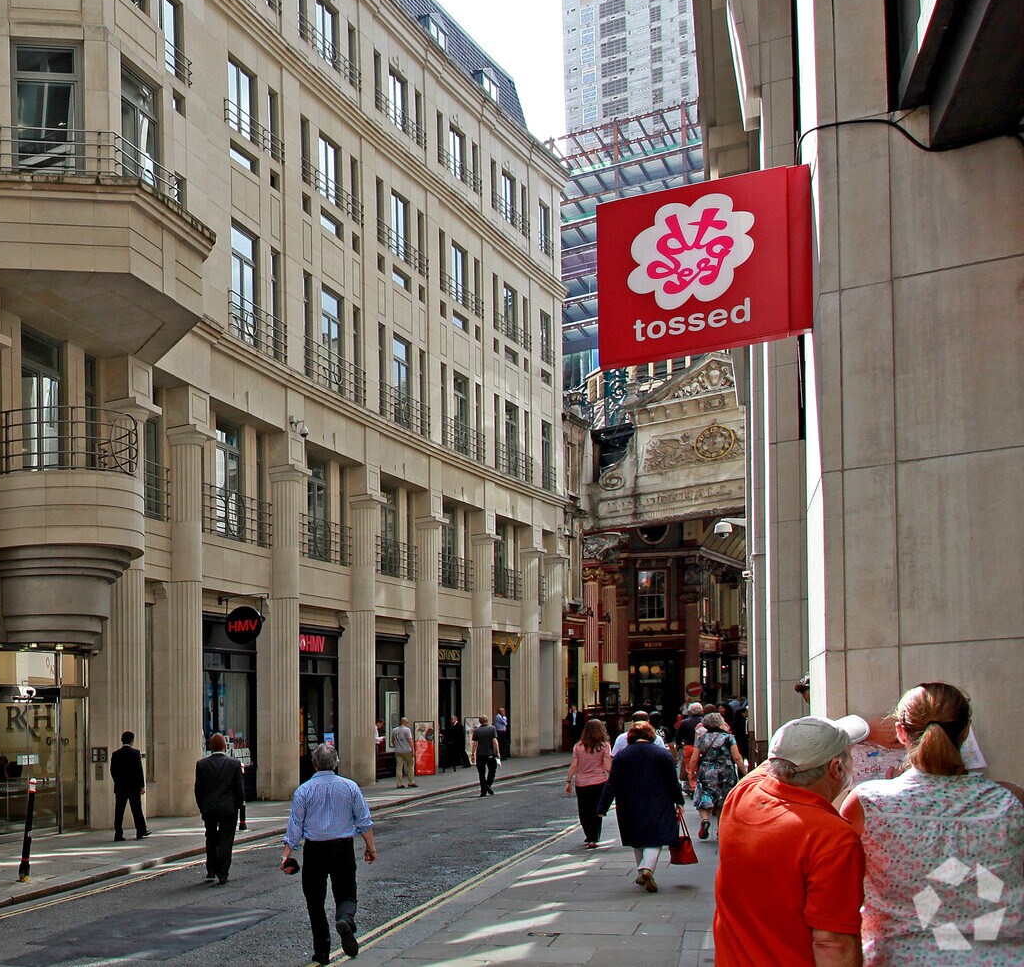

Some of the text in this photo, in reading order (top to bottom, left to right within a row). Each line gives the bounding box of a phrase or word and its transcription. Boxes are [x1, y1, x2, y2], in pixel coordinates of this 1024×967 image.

[632, 297, 751, 342] tossed
[228, 619, 258, 632] HMV
[306, 634, 325, 653] HMV
